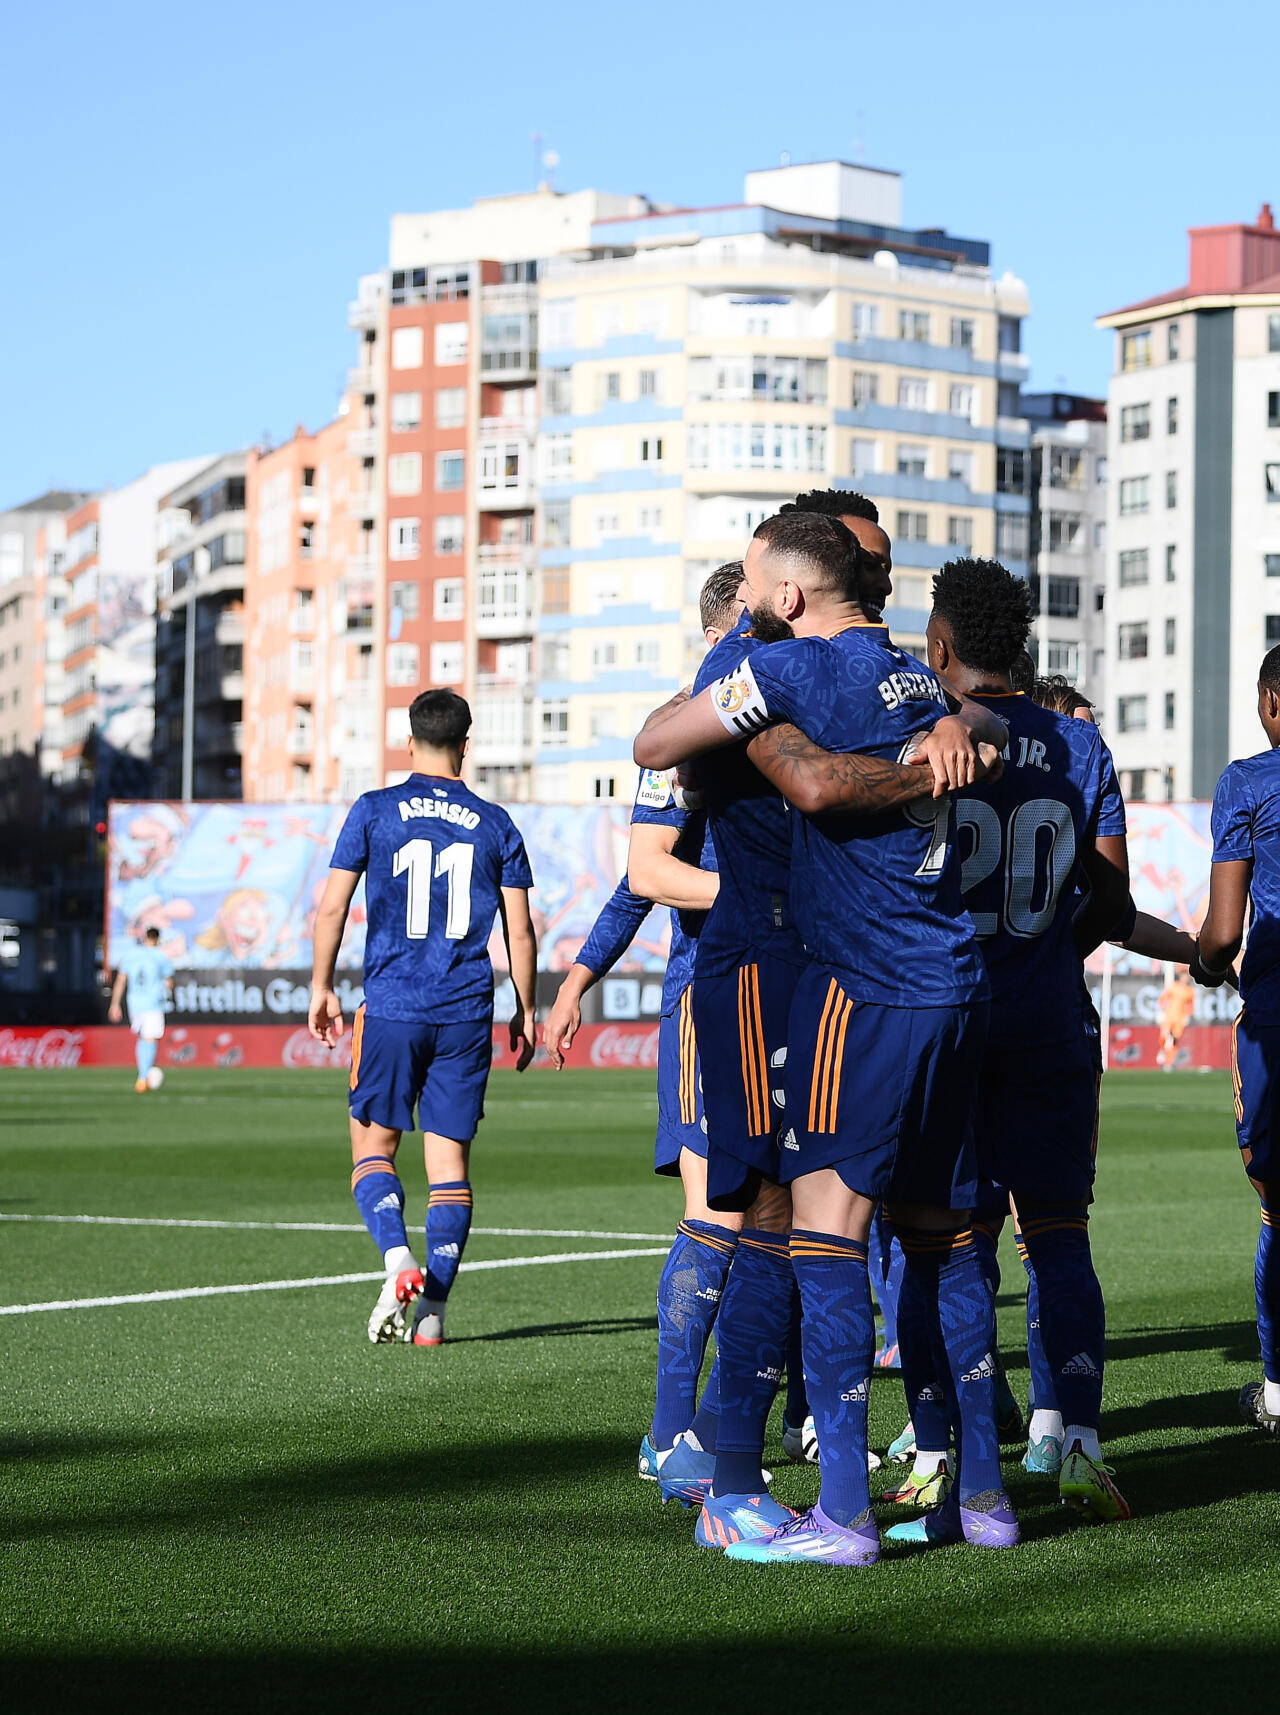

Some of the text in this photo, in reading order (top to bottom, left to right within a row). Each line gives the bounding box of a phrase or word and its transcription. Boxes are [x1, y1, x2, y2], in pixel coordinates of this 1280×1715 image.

[1018, 737, 1051, 772] JR.
[641, 790, 666, 801] LaLiga
[398, 797, 481, 831] ASENSIO
[954, 798, 1076, 939] 20
[392, 838, 475, 939] 11
